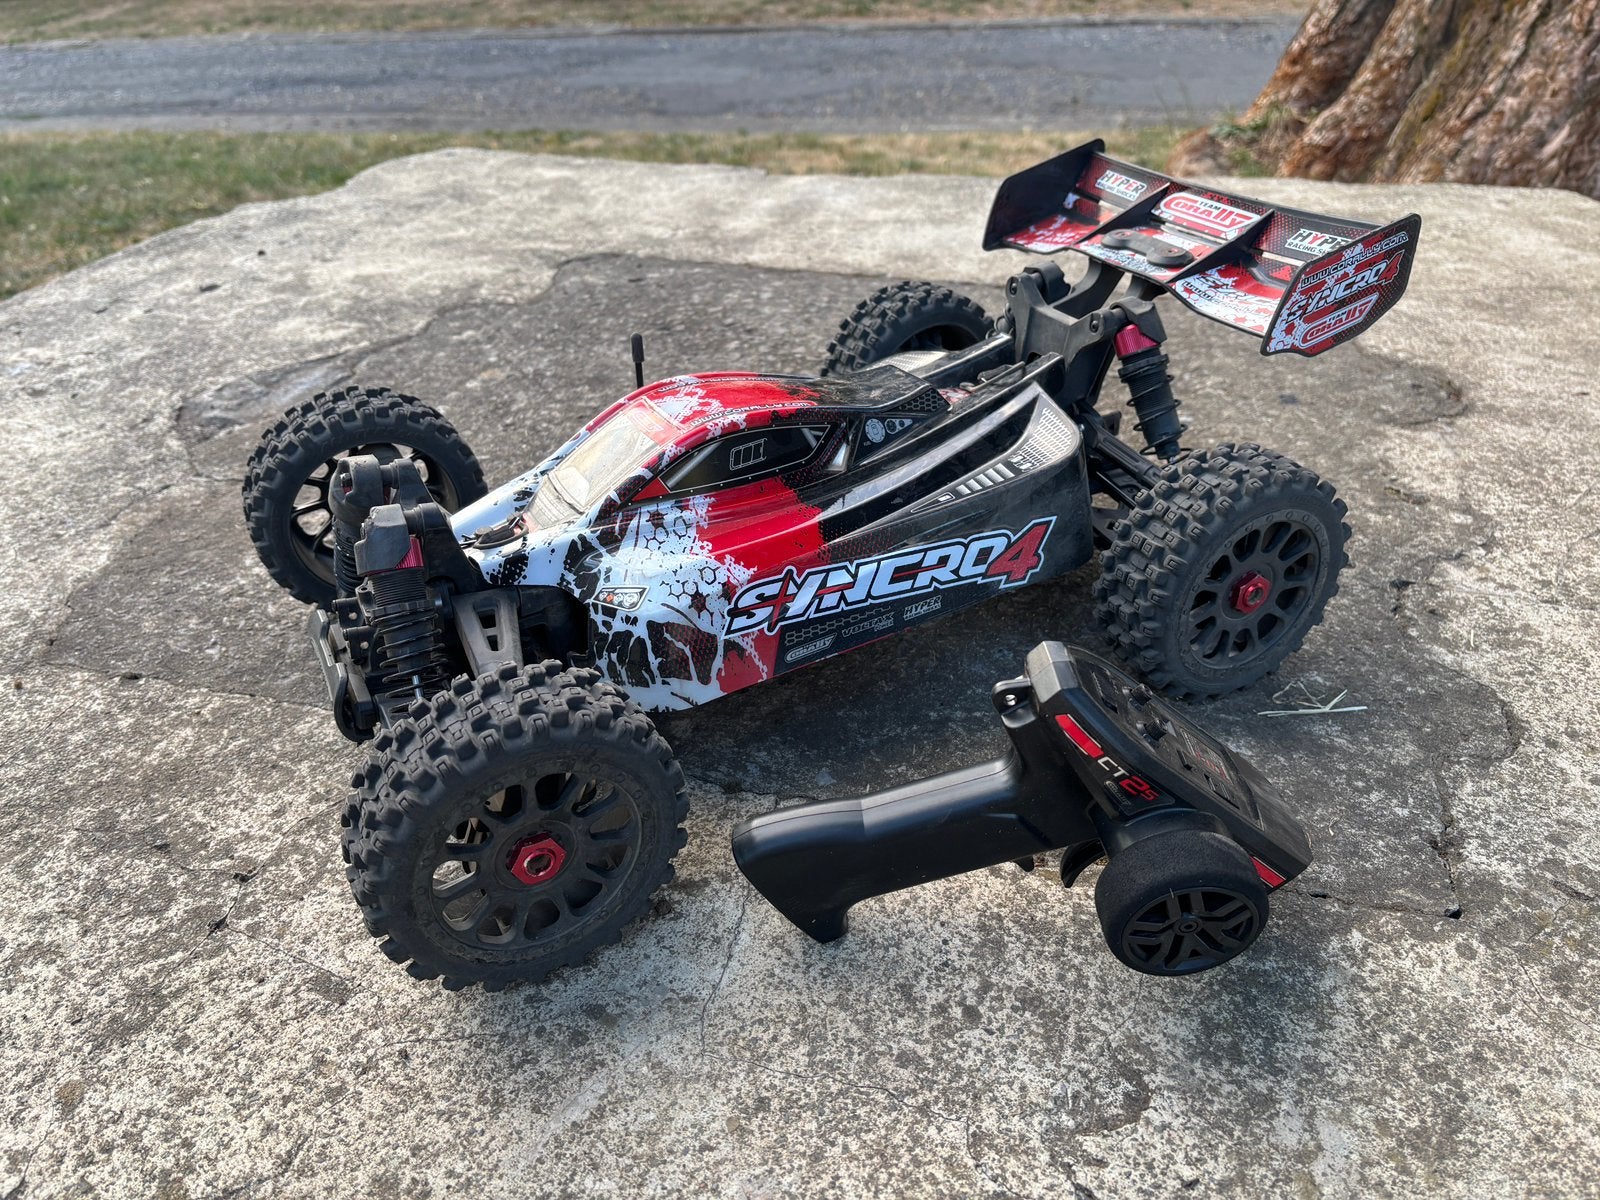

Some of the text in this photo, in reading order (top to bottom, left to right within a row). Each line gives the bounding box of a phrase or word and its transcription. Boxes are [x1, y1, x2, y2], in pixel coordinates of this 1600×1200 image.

[1099, 171, 1147, 193] HYPER
[1198, 201, 1222, 211] TEAM
[1287, 241, 1317, 252] RACING
[1292, 230, 1350, 250] HYPE
[904, 595, 942, 615] HYPER
